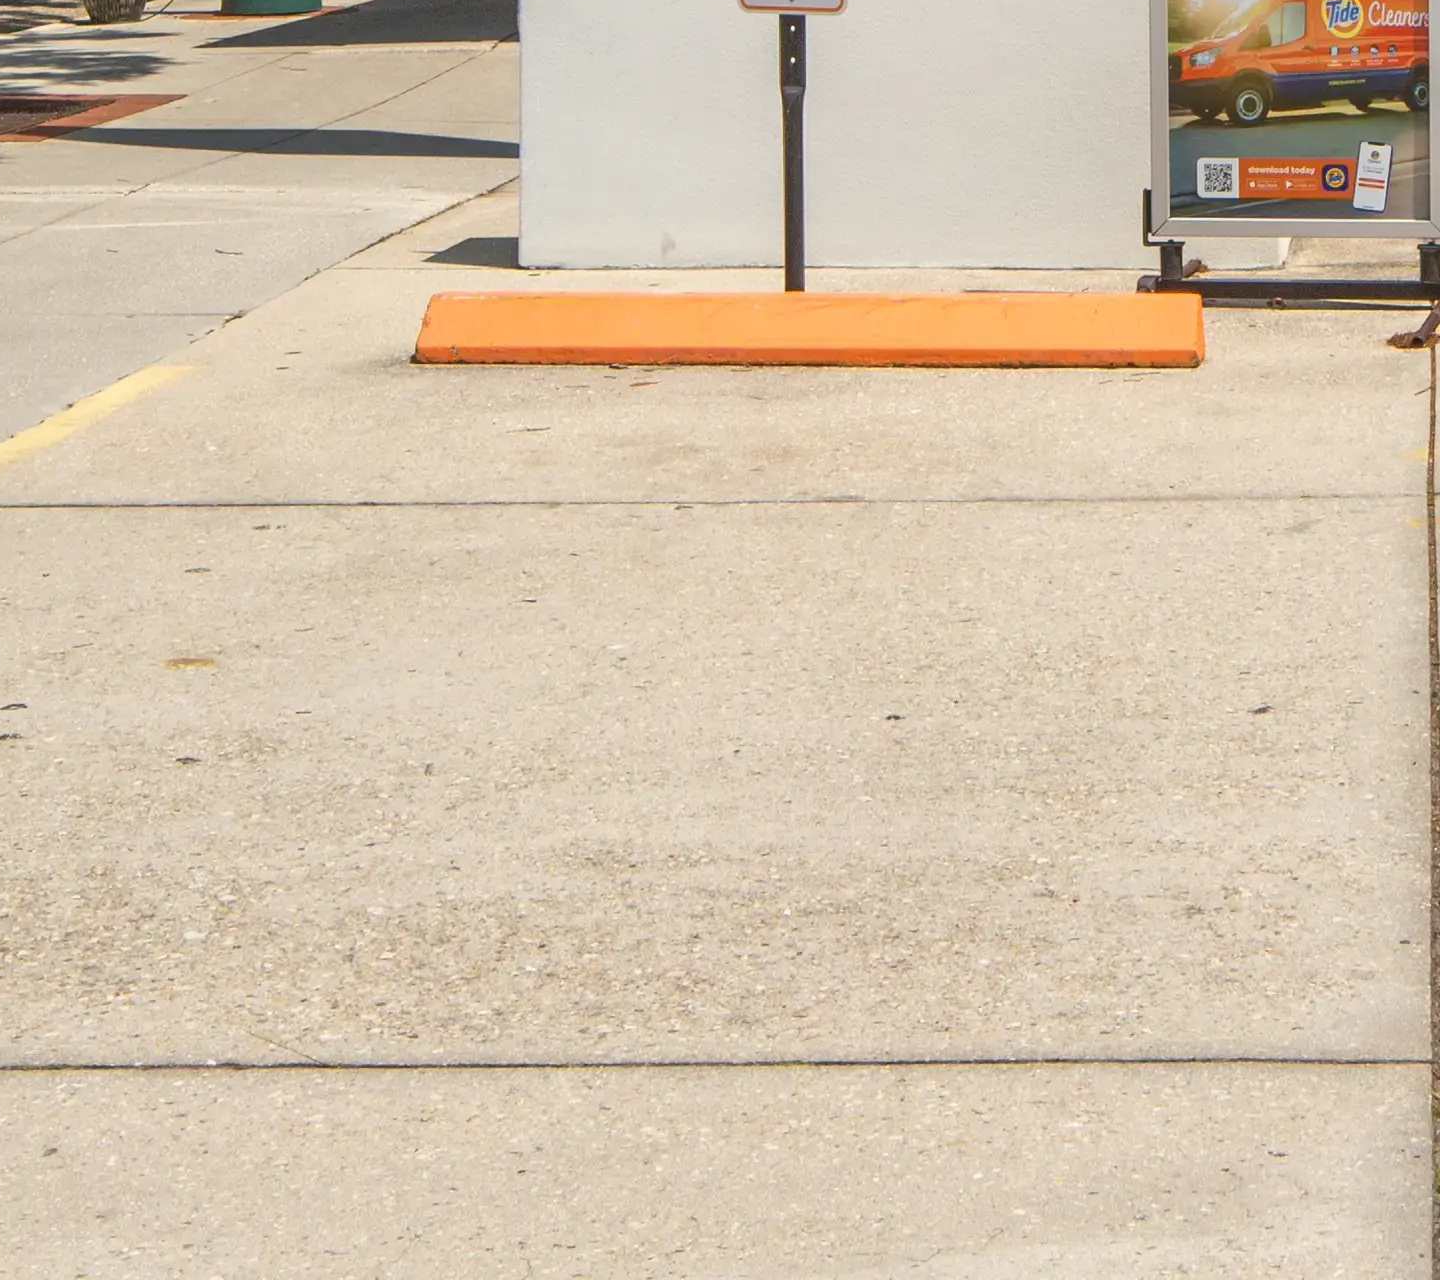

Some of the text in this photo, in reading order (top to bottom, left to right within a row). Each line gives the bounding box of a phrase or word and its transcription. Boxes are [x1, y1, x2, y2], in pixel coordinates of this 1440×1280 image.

[1368, 0, 1430, 27] Cleaners
[1248, 166, 1316, 176] download today
